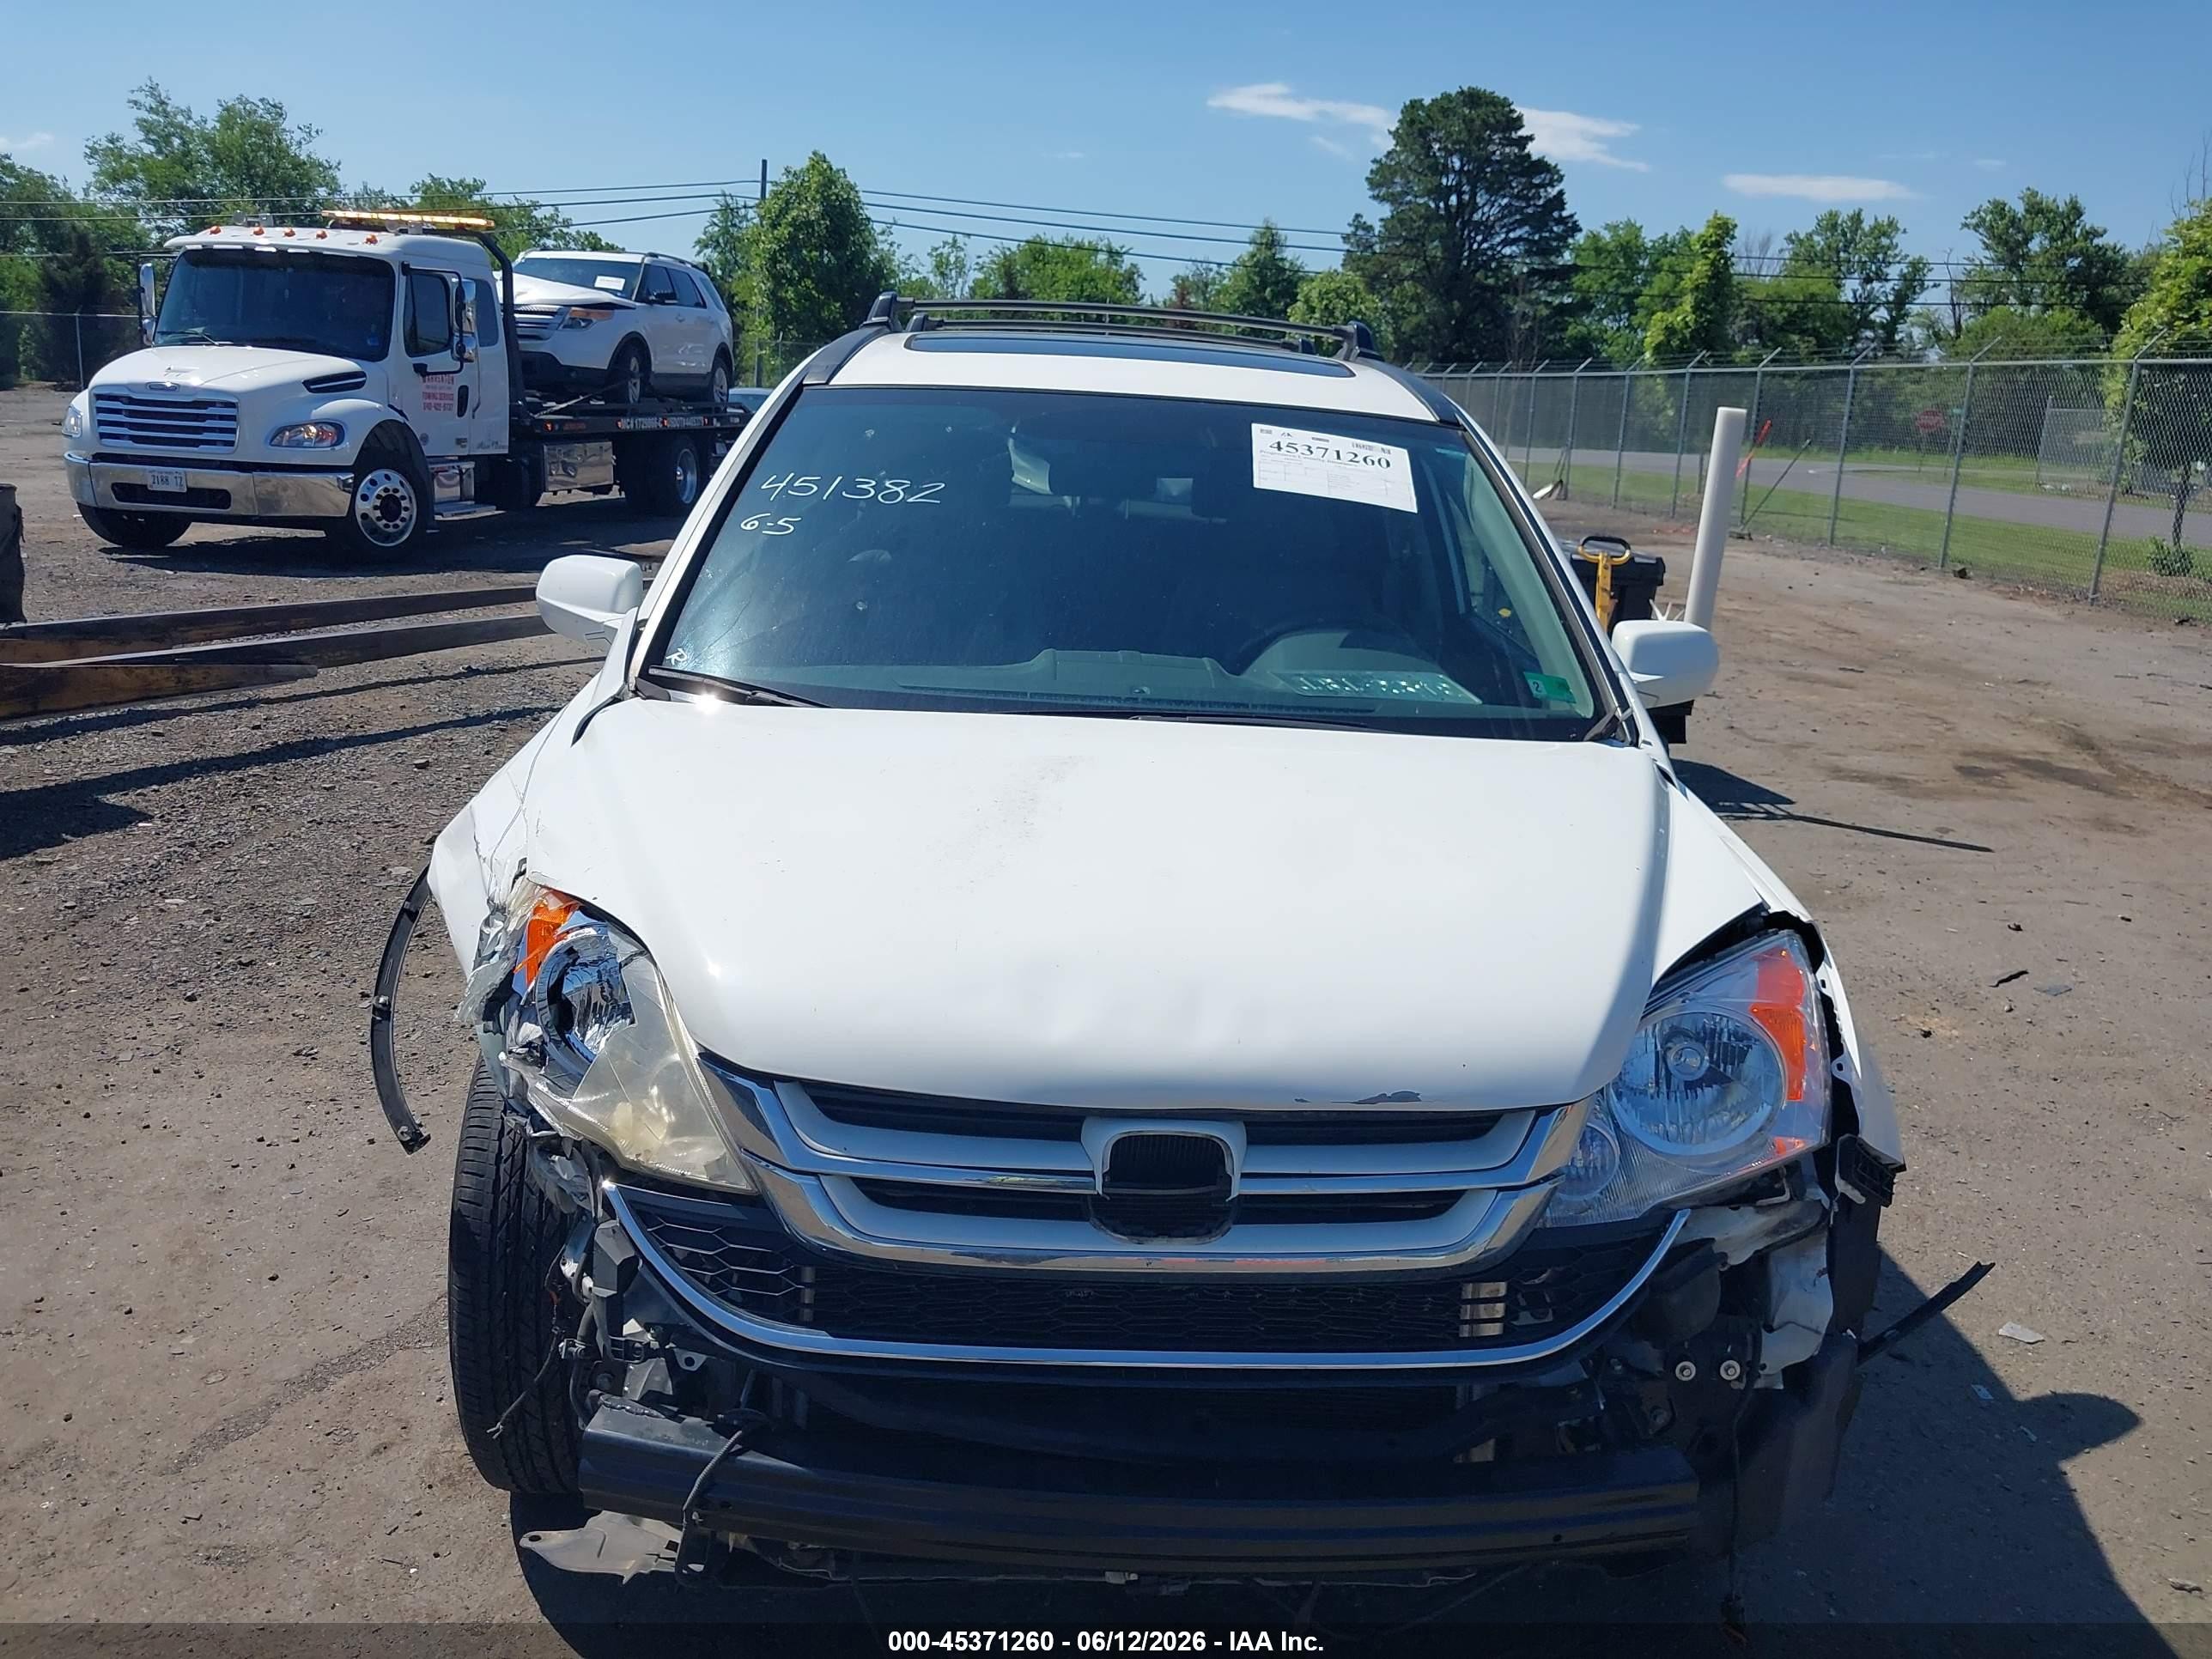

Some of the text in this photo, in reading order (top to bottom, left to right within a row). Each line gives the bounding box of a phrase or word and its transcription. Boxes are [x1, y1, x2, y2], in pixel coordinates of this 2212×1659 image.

[1269, 440, 1391, 470] 45371260
[760, 472, 946, 504] 451382
[740, 513, 802, 535] 6-5
[1532, 680, 1541, 693] 2
